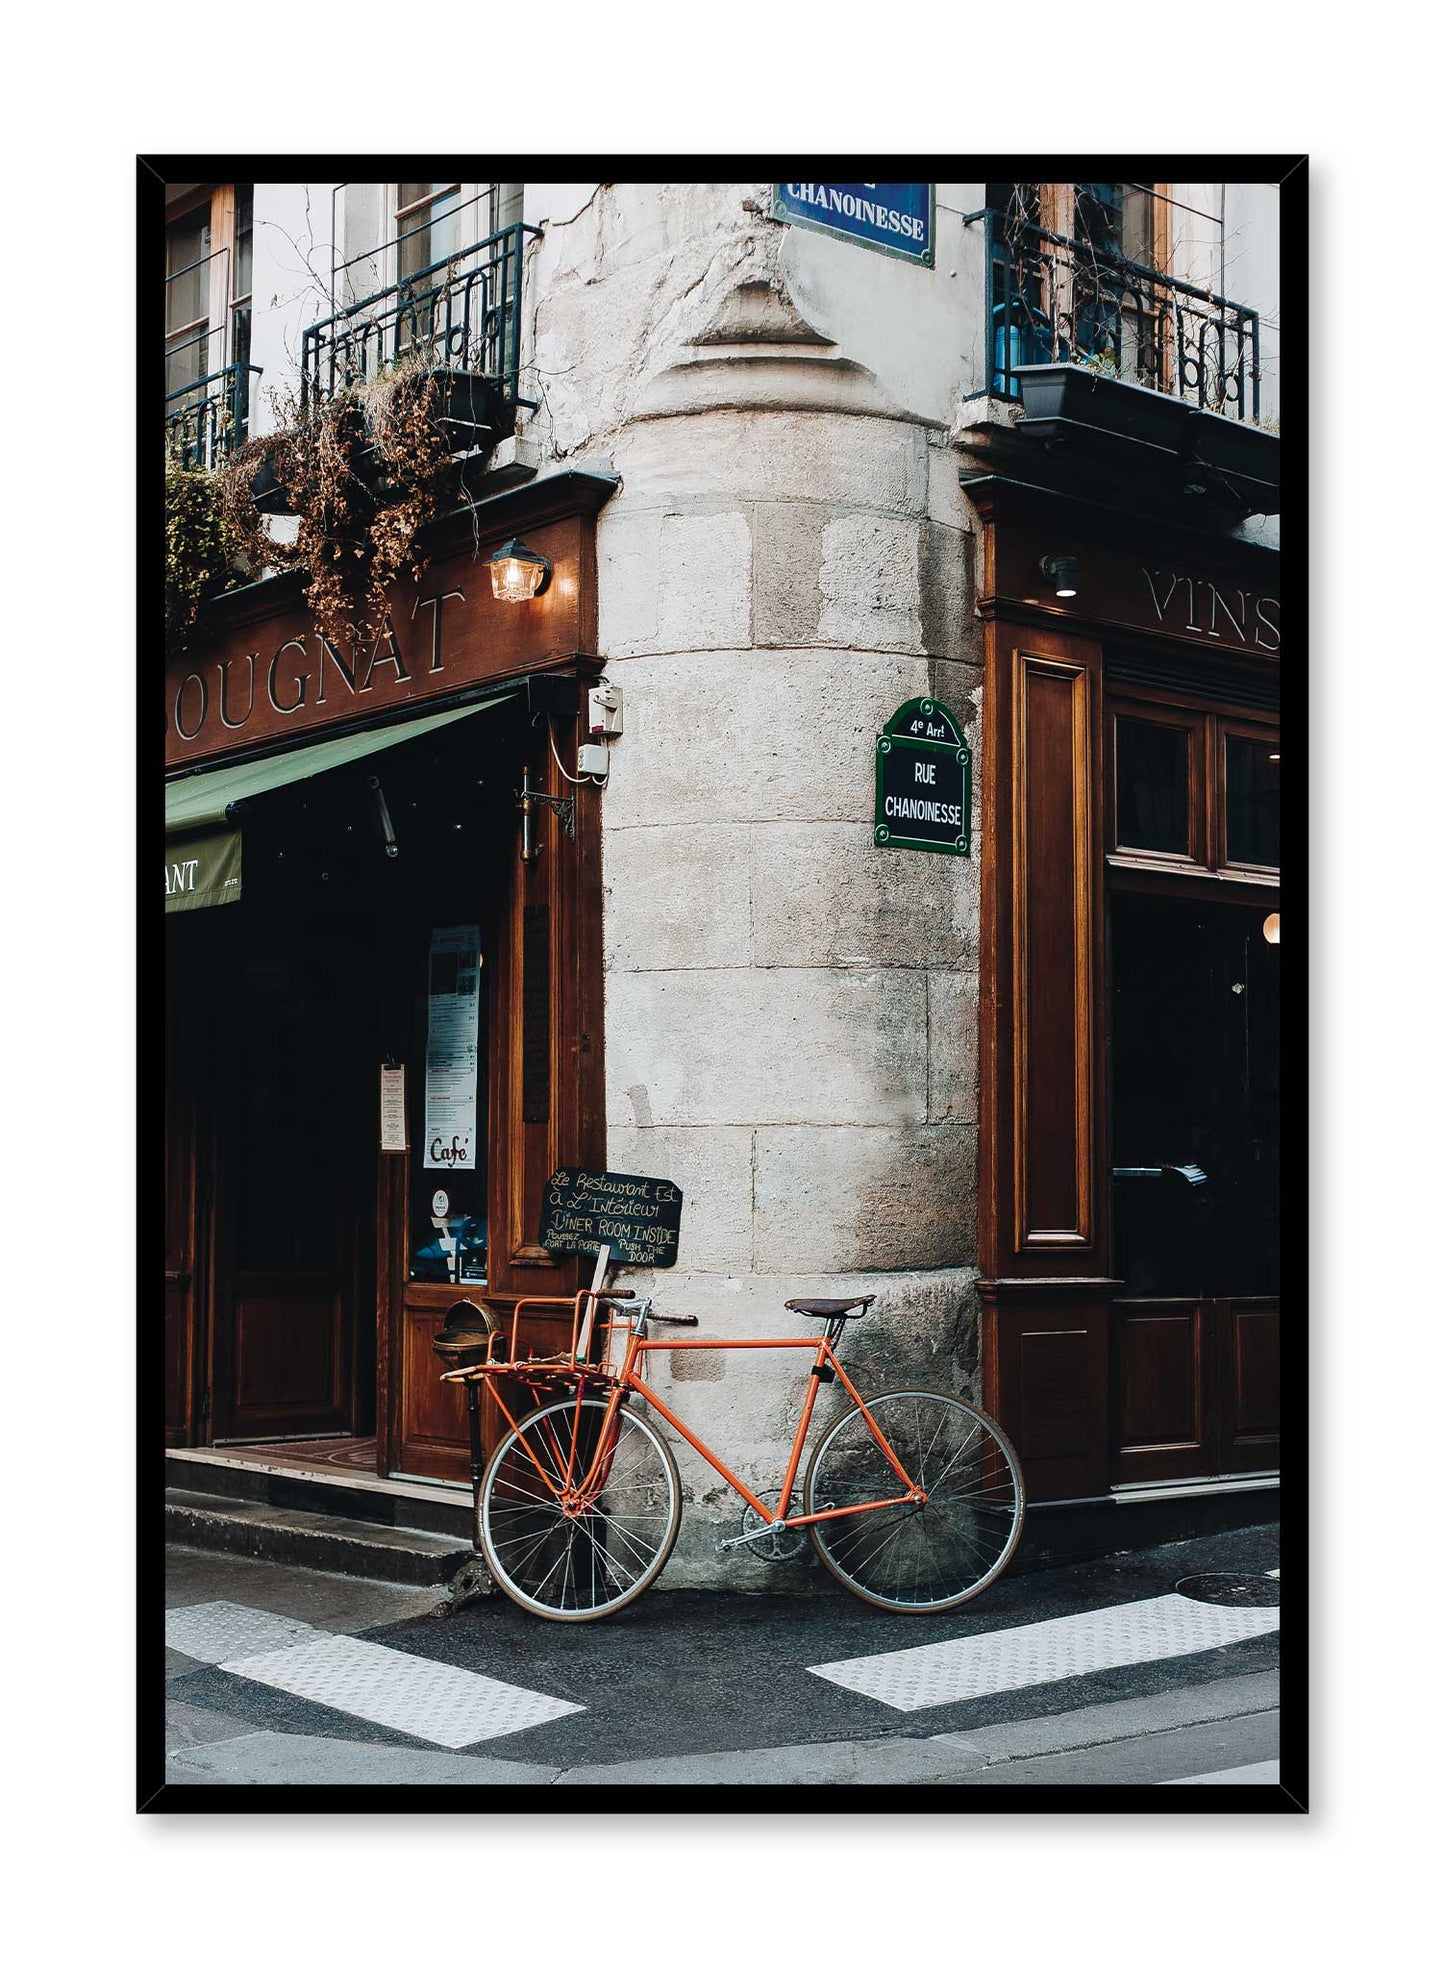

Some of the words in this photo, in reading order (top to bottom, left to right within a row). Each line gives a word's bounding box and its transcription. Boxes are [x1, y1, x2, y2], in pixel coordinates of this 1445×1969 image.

[786, 184, 924, 242] CHANOINESSE
[1141, 566, 1280, 650] VINS
[165, 584, 466, 741] OUGNAT
[914, 762, 937, 785] RUE
[885, 796, 962, 826] CHANOINESSE
[430, 1135, 469, 1168] Café
[550, 1171, 570, 1187] Le
[577, 1173, 650, 1199] Restaurant
[651, 1185, 679, 1203] Est
[599, 1218, 631, 1239] ROOM
[633, 1224, 677, 1246] INSIDE
[618, 1239, 641, 1252] PUSH
[646, 1244, 666, 1255] THE
[627, 1251, 656, 1264] DOOR
